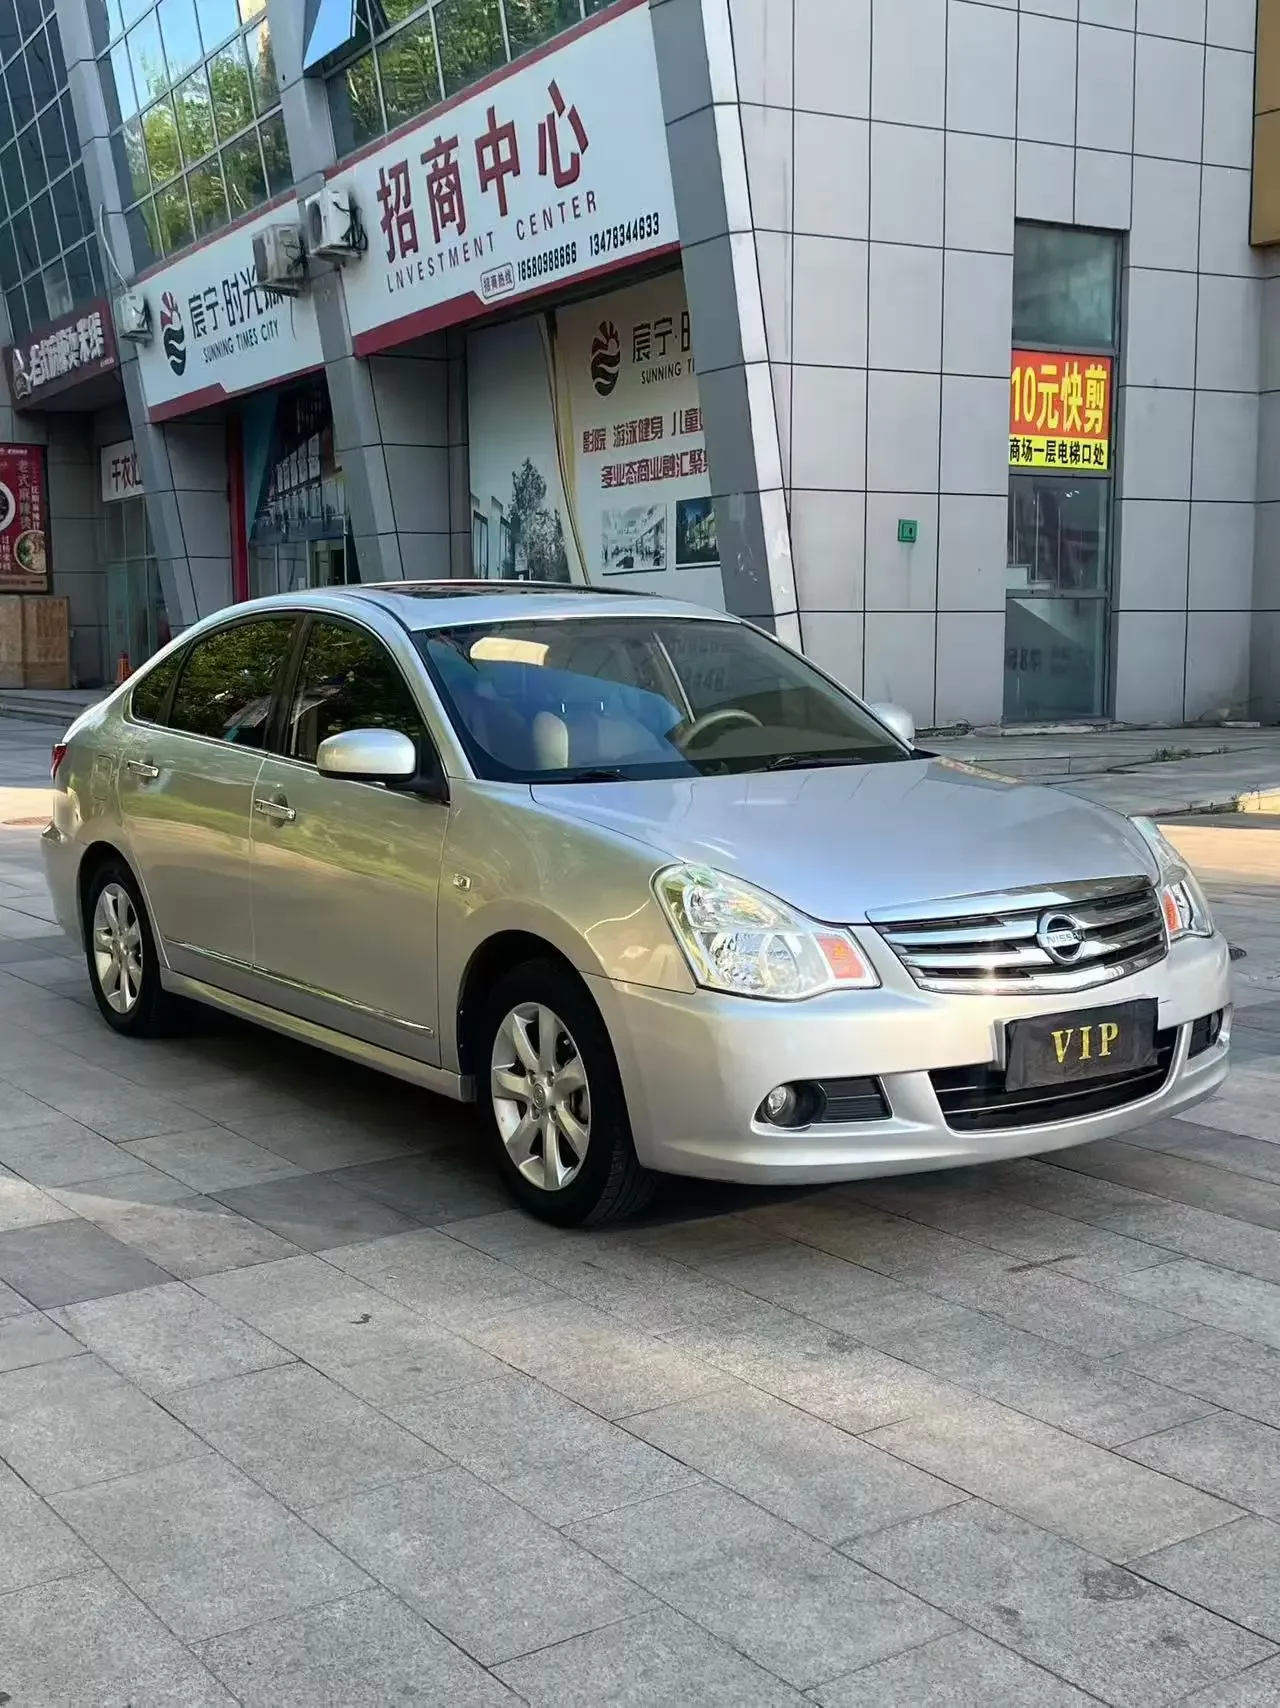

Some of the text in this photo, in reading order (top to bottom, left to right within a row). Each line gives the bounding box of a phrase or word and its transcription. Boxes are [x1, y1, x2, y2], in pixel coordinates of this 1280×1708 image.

[376, 78, 589, 263] 招商中心
[516, 190, 597, 240] CENTER
[483, 265, 513, 293] 招商热线
[589, 211, 660, 256] 13478344633
[203, 319, 280, 363] SUNNING TIMES CITY
[641, 362, 682, 385] SUNNING
[1012, 360, 1107, 434] 10元快剪
[583, 407, 704, 453] 影院 游泳健身 儿童
[1010, 437, 1104, 466] 商场一层电梯口处
[1051, 1022, 1119, 1064] VIP
